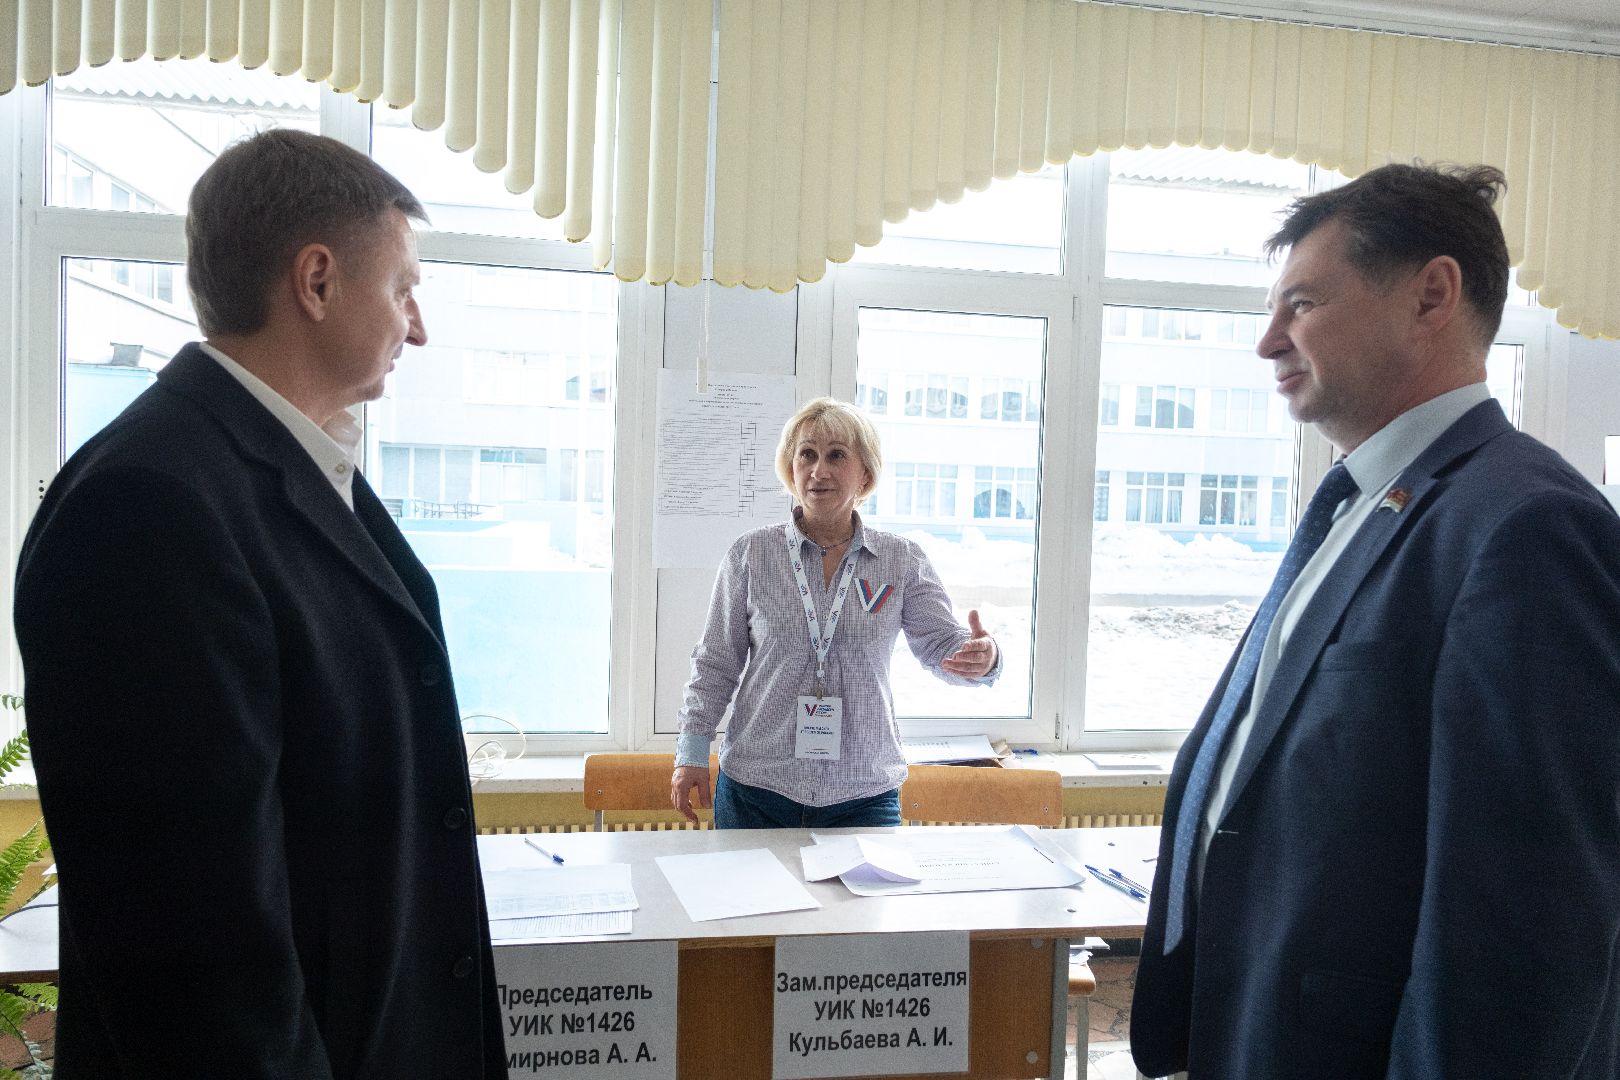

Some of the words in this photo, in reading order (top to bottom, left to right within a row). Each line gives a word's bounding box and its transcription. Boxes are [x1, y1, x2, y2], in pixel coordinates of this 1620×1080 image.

[776, 970, 967, 994] Зам.председателя
[814, 999, 856, 1021] УИК
[862, 997, 931, 1019] №1426
[509, 1014, 554, 1036] УИК
[561, 1010, 636, 1034] №1426
[789, 1029, 900, 1057] Кульбаева
[906, 1027, 927, 1048] А.
[933, 1026, 953, 1047] И.
[506, 1048, 600, 1072] мирнова
[606, 1042, 628, 1064] А.
[635, 1041, 657, 1062] А.
